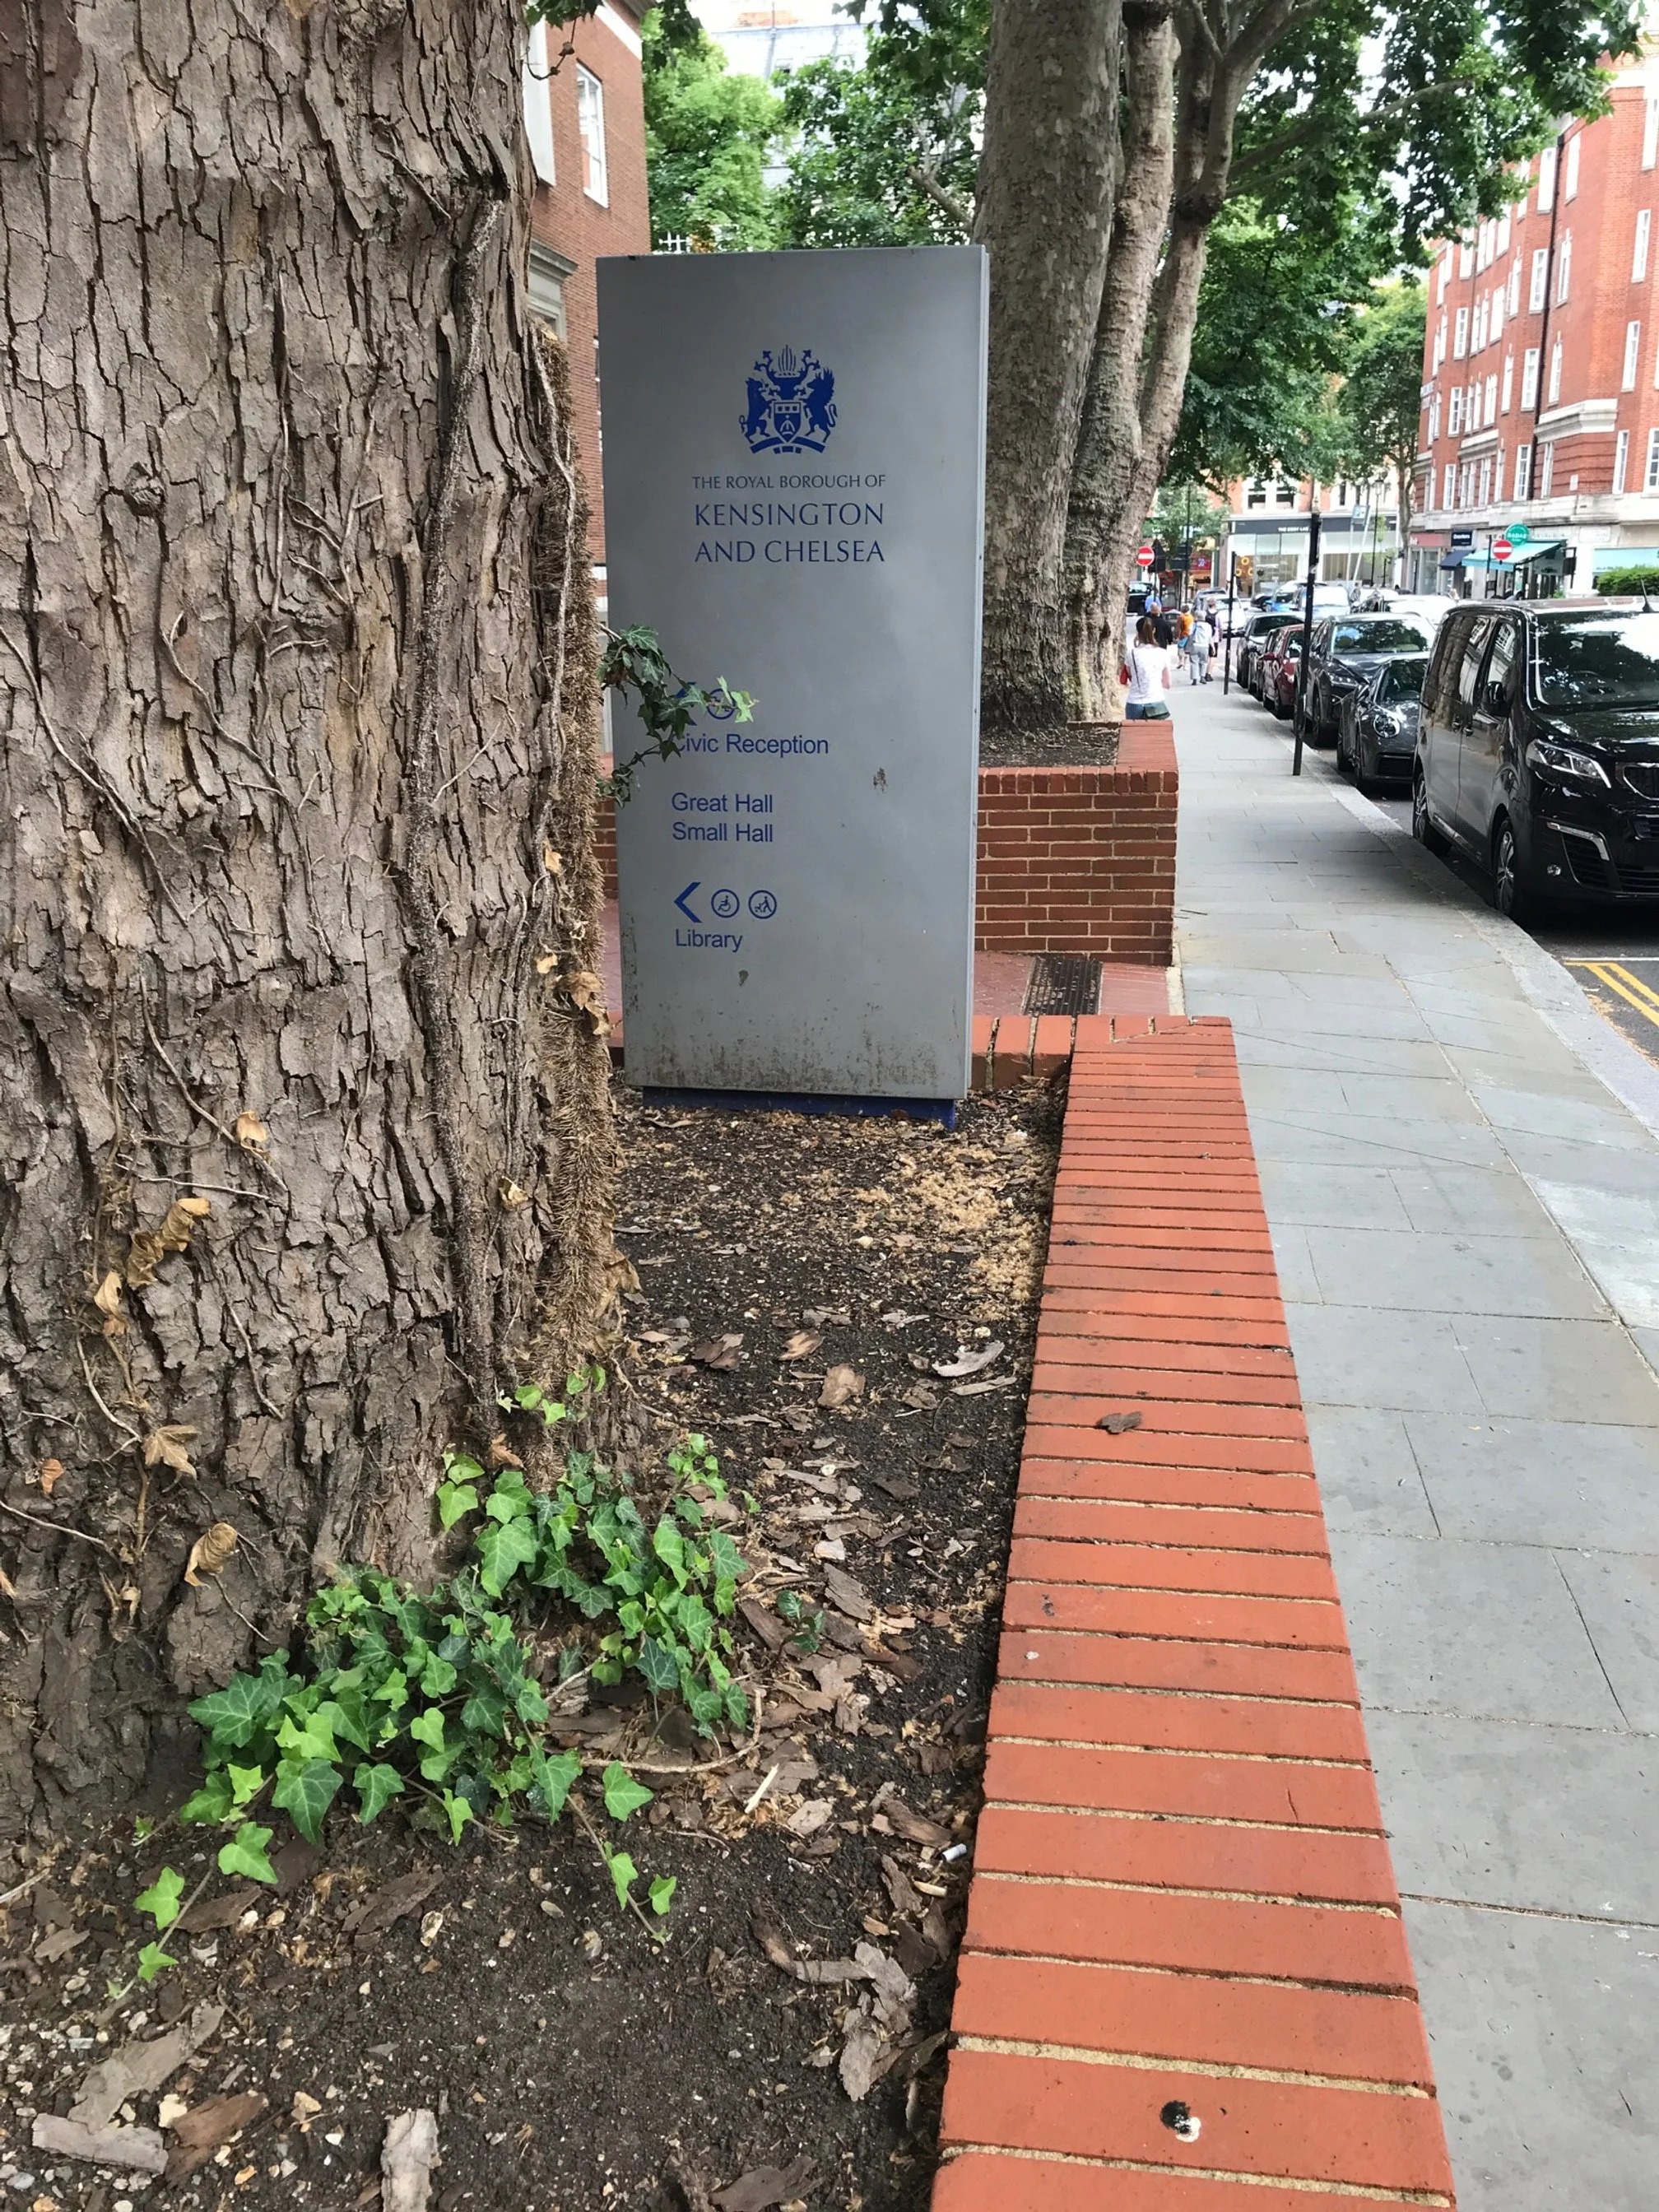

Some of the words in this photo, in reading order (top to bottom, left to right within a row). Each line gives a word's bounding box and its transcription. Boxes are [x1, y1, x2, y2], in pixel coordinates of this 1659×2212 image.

[692, 476, 721, 489] THE
[726, 476, 774, 490] ROYAL
[779, 475, 860, 489] BOROUGH
[864, 475, 885, 487] OF
[695, 503, 884, 526] KENSINGTON
[695, 541, 755, 563] AND
[764, 540, 885, 563] CHELSEA
[726, 734, 829, 758] Reception
[672, 792, 728, 812] Great
[735, 793, 773, 813] Hall
[672, 822, 727, 841] Small
[735, 824, 773, 843] Hall
[676, 929, 743, 953] Library
